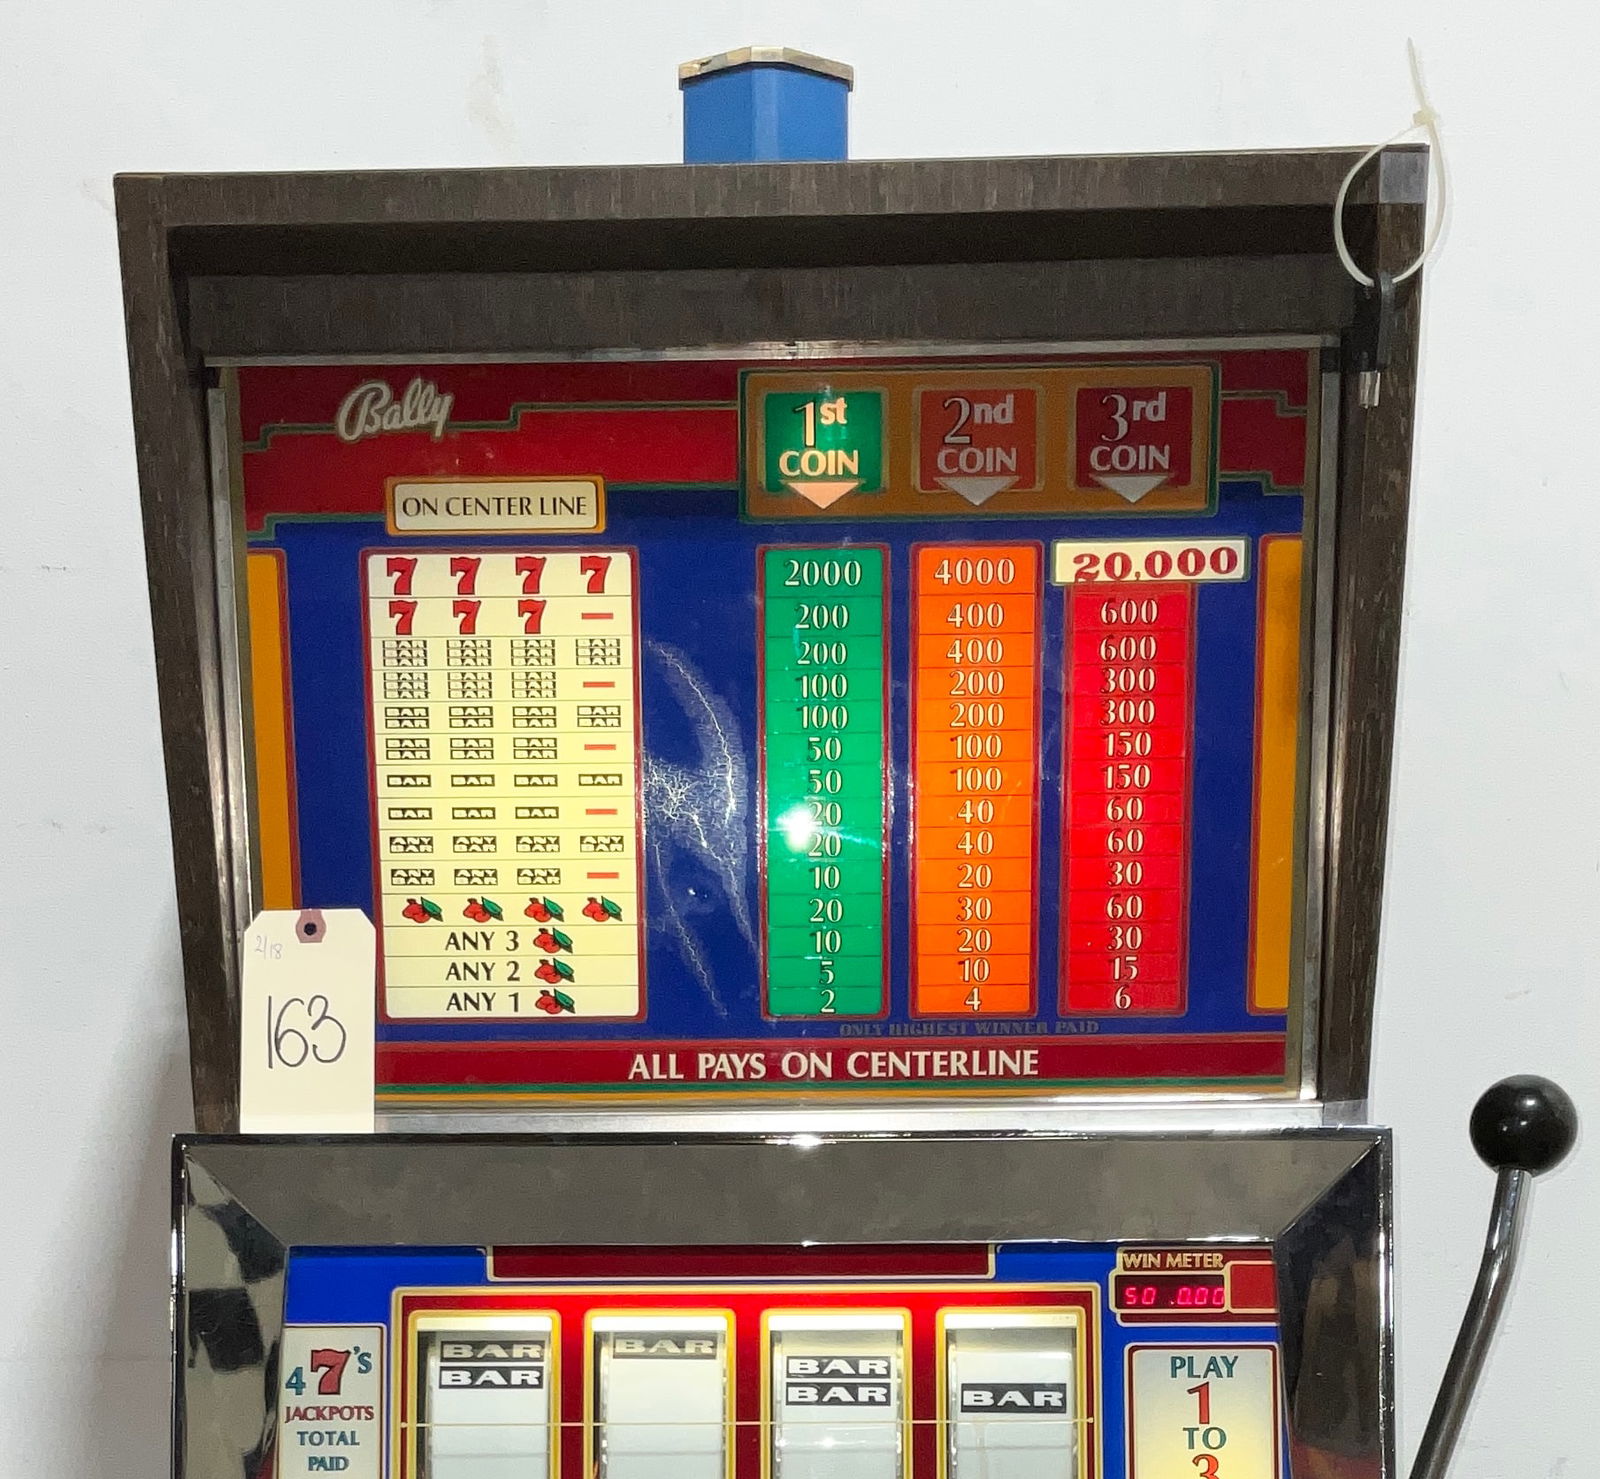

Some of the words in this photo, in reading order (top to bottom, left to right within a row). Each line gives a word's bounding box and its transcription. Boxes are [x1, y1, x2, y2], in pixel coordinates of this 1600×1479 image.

[337, 378, 454, 441] Bally
[794, 396, 848, 449] 1st
[943, 392, 1015, 445] 2nd
[1101, 391, 1166, 443] 3rd
[779, 449, 859, 478] COIN
[937, 446, 1017, 474] COIN
[1090, 443, 1170, 472] COIN
[402, 497, 441, 517] ON
[445, 496, 532, 517] CENTER
[539, 496, 587, 516] LINE
[386, 556, 419, 596] 7
[450, 556, 482, 595] 7
[515, 555, 547, 595] 7
[580, 555, 613, 594] 7
[784, 559, 862, 587] 2000
[933, 557, 1016, 586] 4000
[1072, 546, 1238, 583] 20,000
[389, 600, 420, 636] 7
[453, 599, 483, 635] 7
[518, 599, 548, 635] 7
[794, 604, 850, 630] 200
[946, 601, 1005, 629] 400
[1100, 597, 1158, 625] 600
[796, 641, 848, 665] 200
[946, 638, 1005, 664] 400
[1100, 634, 1158, 662] 600
[795, 673, 849, 699] 100
[949, 669, 1005, 696] 200
[1100, 667, 1156, 695] 300
[386, 707, 429, 717] BAR
[449, 706, 493, 716] BAR
[513, 706, 556, 716] BAR
[577, 706, 620, 716] BAR
[386, 718, 429, 728] BAR
[449, 718, 493, 728] BAR
[513, 718, 556, 728] BAR
[577, 717, 621, 727] BAR
[796, 705, 849, 730] 100
[949, 702, 1005, 728] 200
[1100, 698, 1156, 726] 300
[386, 738, 429, 748] BAR
[450, 738, 493, 748] BAR
[513, 737, 557, 748] BAR
[386, 750, 430, 760] BAR
[450, 750, 494, 760] BAR
[513, 749, 557, 759] BAR
[807, 736, 842, 762] 50
[950, 733, 1003, 759] 100
[1103, 731, 1152, 757] 150
[387, 775, 431, 787] BAR
[451, 774, 495, 787] BAR
[514, 774, 558, 787] BAR
[578, 774, 622, 786] BAR
[807, 769, 842, 795] 50
[950, 766, 1003, 792] 100
[1103, 764, 1151, 790] 150
[388, 807, 432, 819] BAR
[452, 807, 496, 819] BAR
[515, 807, 559, 819] BAR
[808, 801, 842, 827] 20
[957, 798, 995, 824] 40
[1106, 796, 1143, 822] 60
[390, 836, 433, 845] ANY
[453, 836, 497, 845] ANY
[516, 836, 560, 844] ANY
[580, 836, 624, 844] ANY
[390, 845, 433, 853] BAR
[453, 844, 497, 853] BAR
[516, 844, 560, 852] BAR
[580, 844, 624, 852] BAR
[808, 831, 842, 857] 20
[957, 830, 995, 856] 40
[1106, 828, 1144, 854] 60
[391, 869, 435, 877] ANY
[454, 869, 498, 877] ANY
[517, 868, 560, 877] ANY
[391, 877, 435, 885] BAR
[454, 877, 498, 885] BAR
[517, 876, 560, 885] BAR
[808, 865, 841, 890] 10
[957, 863, 993, 889] 20
[1107, 860, 1143, 886] 30
[808, 898, 843, 923] 20
[956, 895, 993, 922] 30
[1106, 893, 1143, 920] 60
[445, 931, 498, 952] ANY
[505, 931, 520, 952] 3
[809, 929, 841, 954] 10
[957, 927, 993, 953] 20
[1107, 925, 1143, 951] 30
[446, 962, 499, 982] ANY
[506, 961, 521, 982] 2
[819, 960, 835, 985] 5
[957, 957, 991, 983] 10
[1110, 955, 1139, 981] 15
[446, 992, 499, 1013] ANY
[508, 992, 520, 1013] 1
[820, 989, 836, 1013] 2
[964, 987, 982, 1011] 4
[1114, 986, 1132, 1010] 6
[268, 995, 346, 1069] 163
[840, 1023, 884, 1037] ONLY
[889, 1022, 967, 1036] HIGHEST
[975, 1021, 1048, 1035] WINNER
[1055, 1020, 1099, 1034] PAID
[628, 1053, 683, 1079] ALL
[698, 1052, 766, 1078] PAYS
[781, 1051, 833, 1079] ON
[846, 1049, 1039, 1079] CENTERLINE
[1123, 1252, 1161, 1269] WIN
[1166, 1252, 1224, 1269] METER
[441, 1341, 544, 1361] BAR
[614, 1337, 714, 1357] BAR
[440, 1367, 541, 1388] BAR
[787, 1356, 889, 1378] BAR
[1170, 1355, 1239, 1379] PLAY
[285, 1366, 306, 1396] 4
[787, 1383, 889, 1405] BAR
[962, 1388, 1064, 1409] BAR
[1186, 1381, 1210, 1425] 1
[284, 1405, 375, 1423] JACKPOTS
[296, 1430, 360, 1446] TOTAL
[1182, 1426, 1227, 1450] TO
[307, 1456, 350, 1472] PAID
